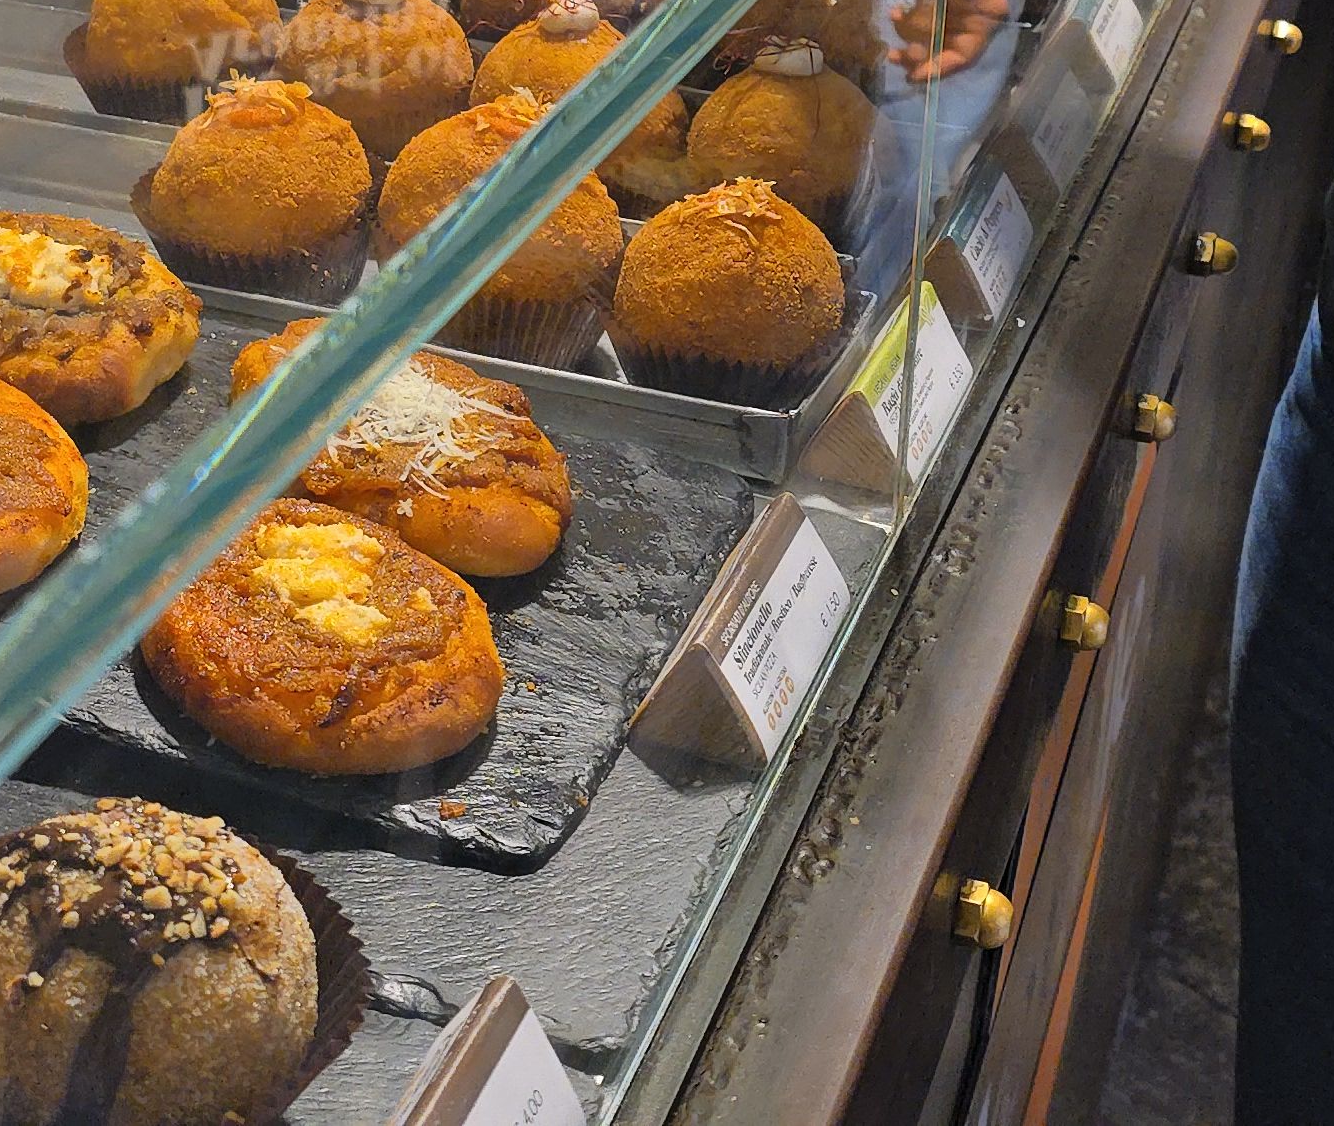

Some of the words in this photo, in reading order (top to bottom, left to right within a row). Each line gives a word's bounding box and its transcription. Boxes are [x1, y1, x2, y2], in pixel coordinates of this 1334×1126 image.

[733, 601, 773, 670] Sfincionello
[826, 591, 841, 619] 1,50
[743, 630, 774, 685] Tradizionale
[771, 598, 792, 634] Rustico
